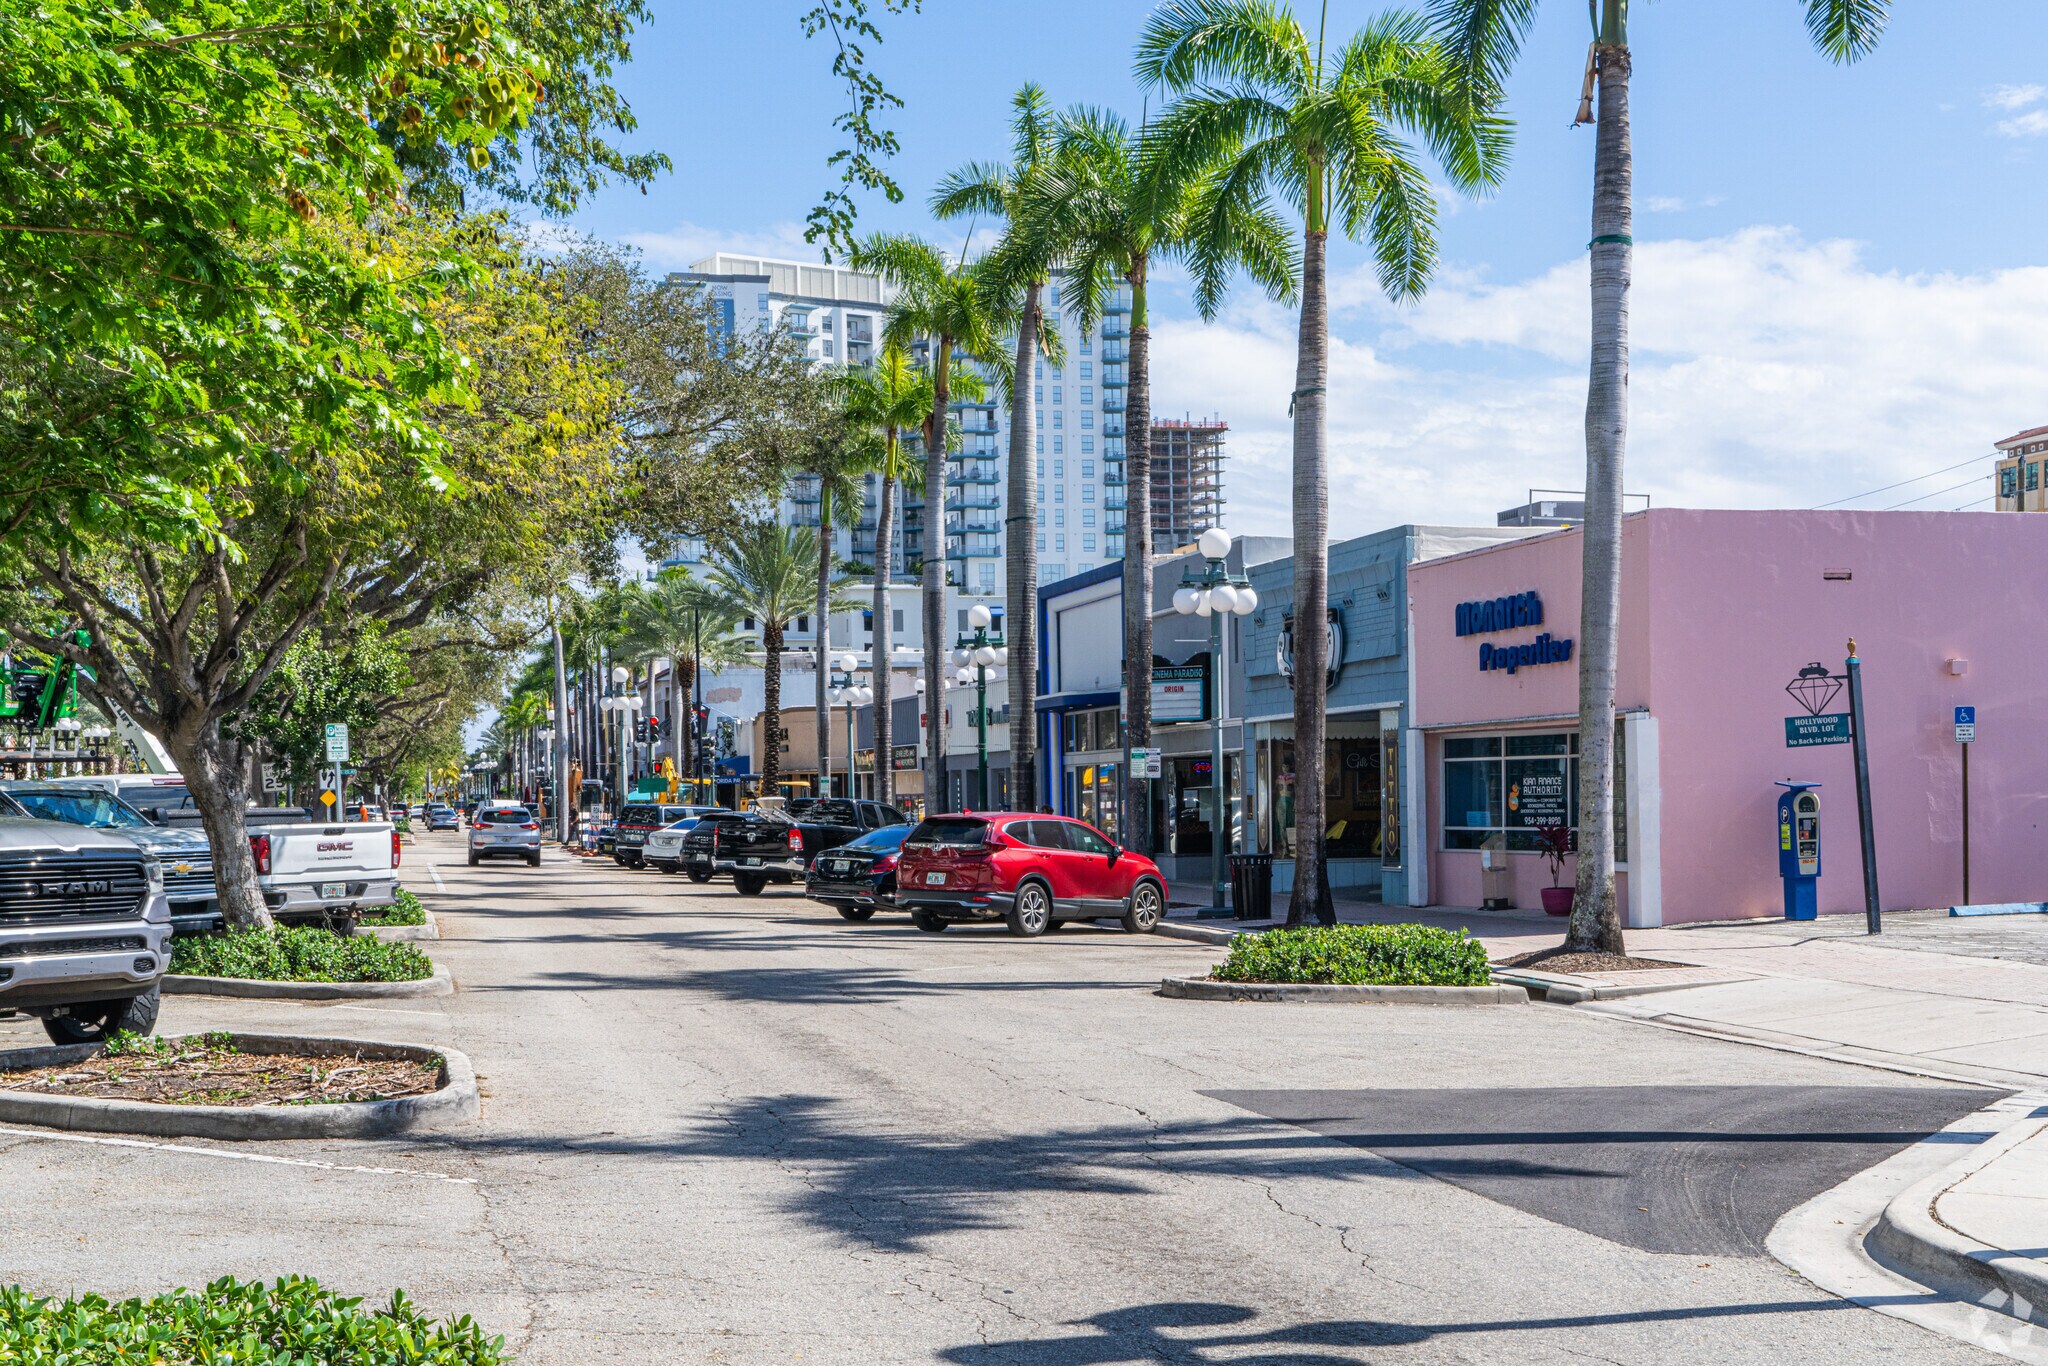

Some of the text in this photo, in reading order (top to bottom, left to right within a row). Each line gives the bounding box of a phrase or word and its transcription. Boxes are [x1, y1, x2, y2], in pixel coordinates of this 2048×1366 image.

[1479, 633, 1572, 674] Properties
[1151, 668, 1204, 679] CINEMA PARADISO
[1164, 685, 1184, 693] ORIGIN
[117, 708, 133, 728] LIFT
[1794, 716, 1838, 726] HOLLYWOOD
[1799, 726, 1820, 734] BLVD.
[1798, 737, 1822, 745] Back-in
[1538, 776, 1562, 785] FINANCE
[1523, 785, 1562, 794] AUTHORITY
[1387, 748, 1395, 845] TATTOO
[317, 841, 353, 852] GMC
[42, 880, 108, 894] RAM
